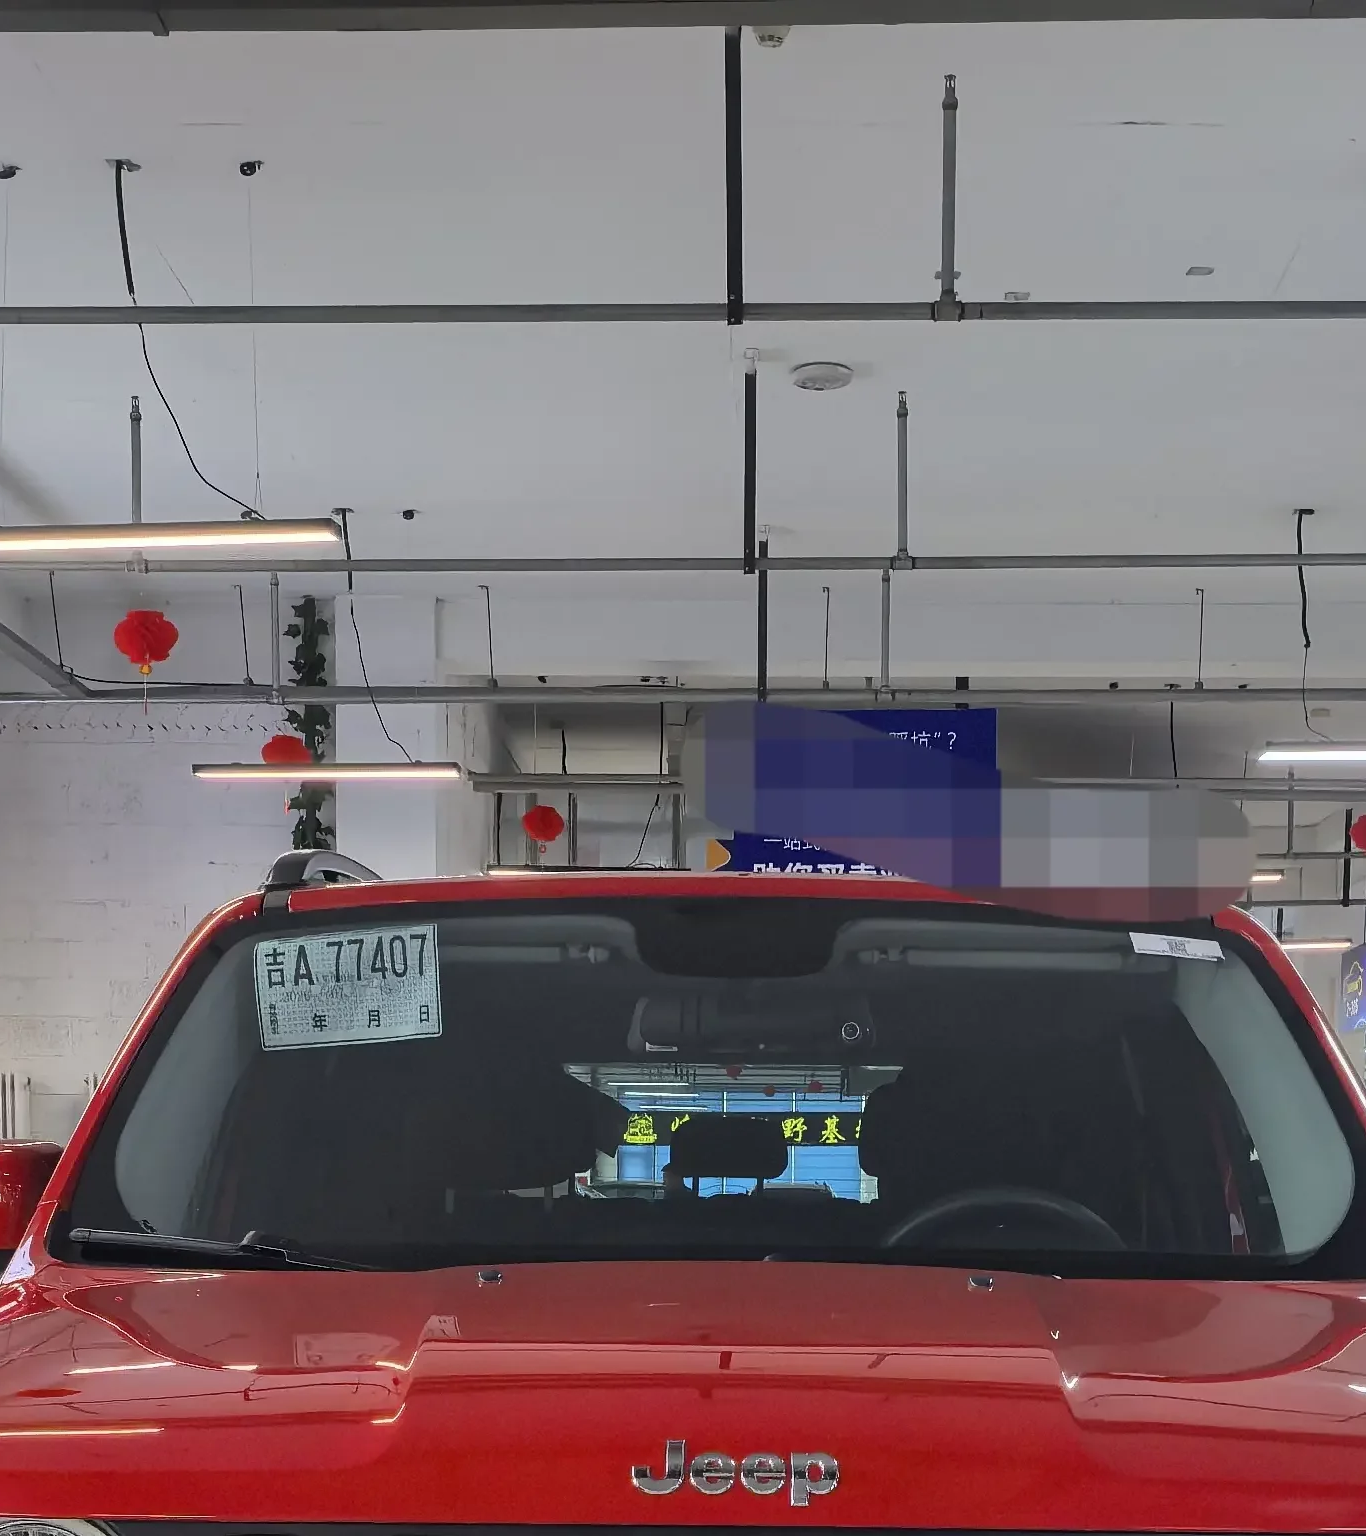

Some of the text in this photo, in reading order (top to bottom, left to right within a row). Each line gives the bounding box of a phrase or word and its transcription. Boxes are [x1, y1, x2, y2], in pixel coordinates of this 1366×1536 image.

[368, 1009, 381, 1028] 月
[419, 1004, 430, 1023] 日
[631, 1439, 841, 1507] Jeep
